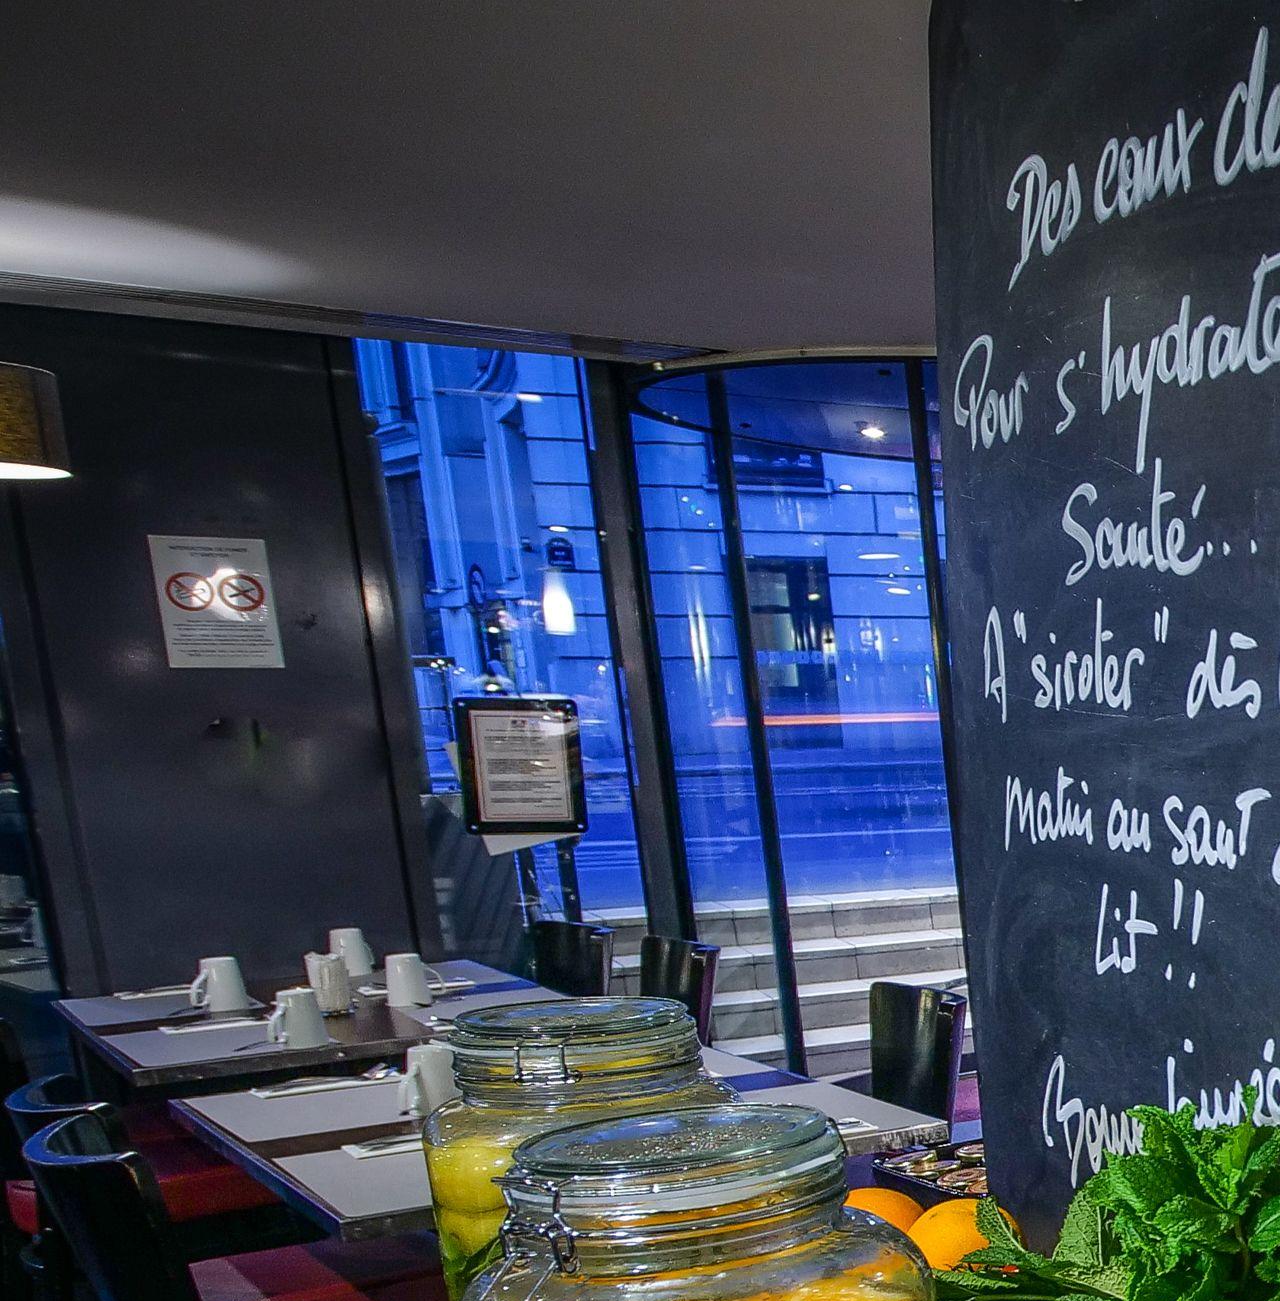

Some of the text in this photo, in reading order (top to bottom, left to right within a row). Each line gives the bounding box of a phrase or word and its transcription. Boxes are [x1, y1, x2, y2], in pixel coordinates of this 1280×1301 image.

[1006, 154, 1081, 292] Des
[1093, 108, 1204, 223] eaux
[954, 334, 1028, 452] Pour
[1106, 798, 1151, 853] au
